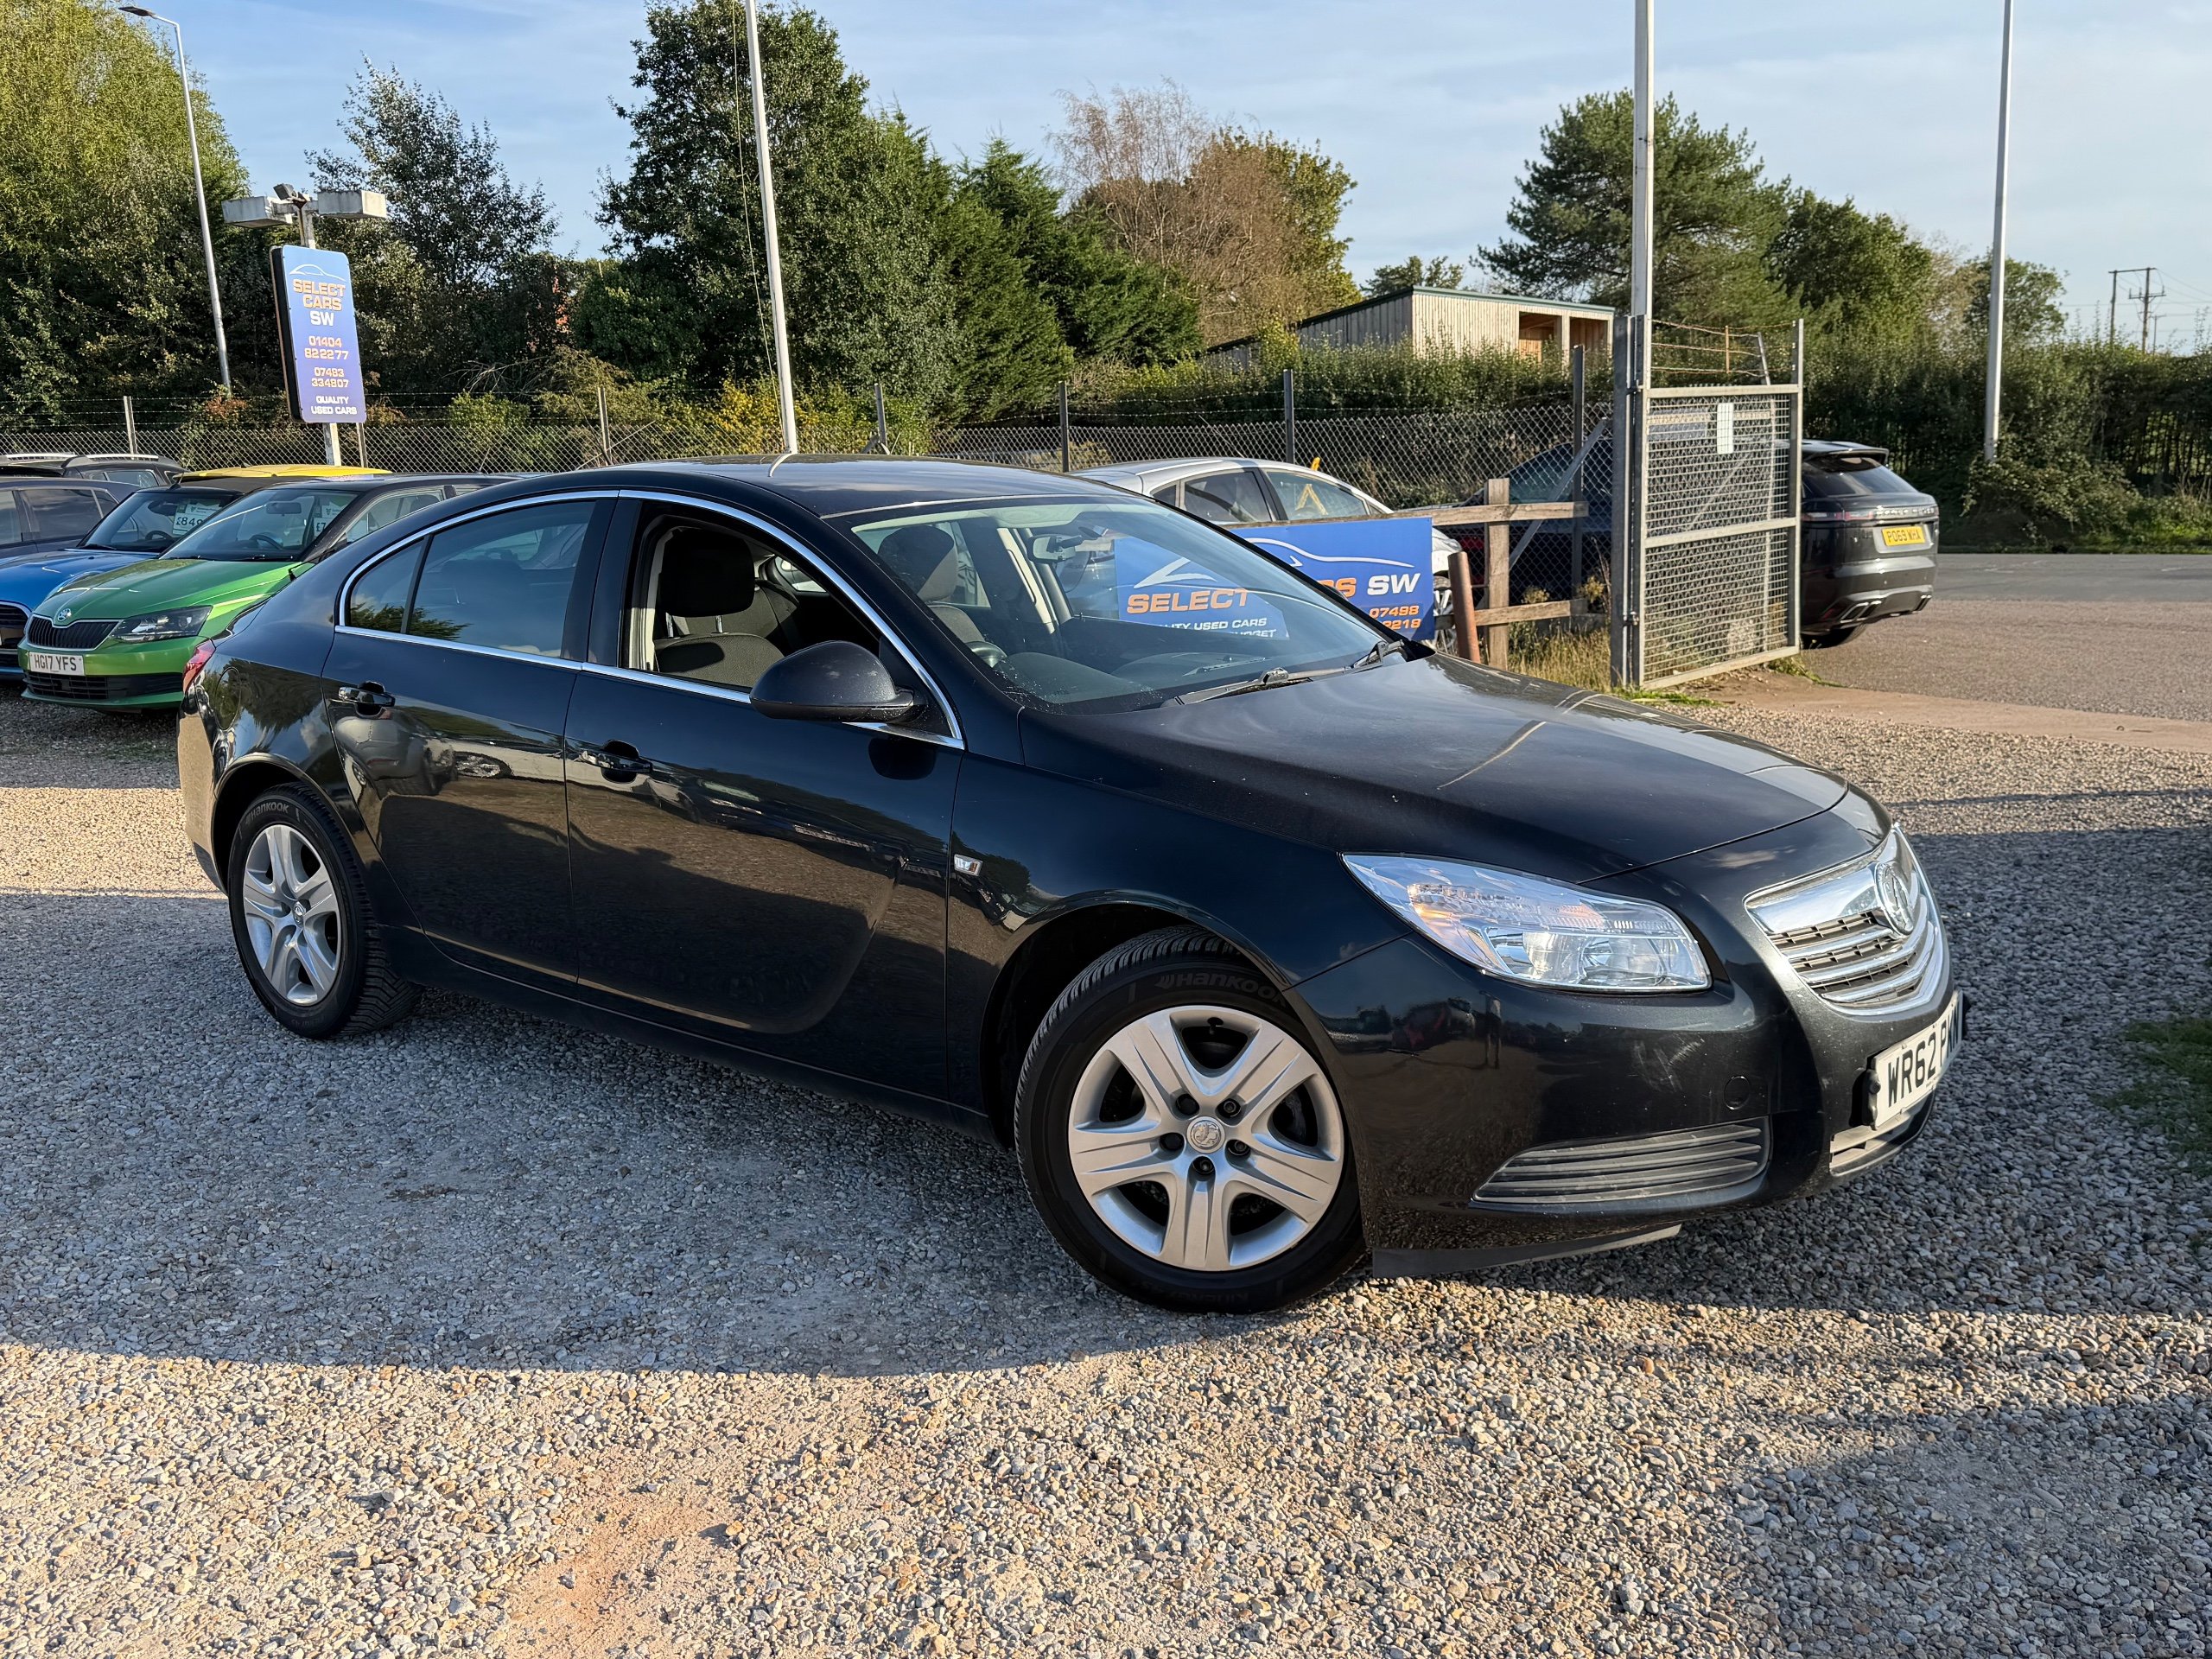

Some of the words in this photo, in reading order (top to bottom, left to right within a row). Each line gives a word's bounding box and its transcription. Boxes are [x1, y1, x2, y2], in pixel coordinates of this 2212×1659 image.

[293, 279, 346, 296] SELECT
[302, 296, 342, 311] CARS
[309, 310, 334, 327] SW
[308, 335, 342, 347] 01404
[304, 347, 349, 360] 822277
[315, 395, 349, 404] QUALITY
[310, 405, 334, 415] USED
[334, 405, 357, 415] CARS
[1126, 588, 1249, 614] SELECT
[1367, 573, 1421, 595] SW
[1193, 621, 1229, 631] USED
[1231, 618, 1268, 629] CARS
[34, 654, 54, 670] HG17
[55, 656, 77, 671] YFS
[1888, 1031, 1936, 1108] WR62
